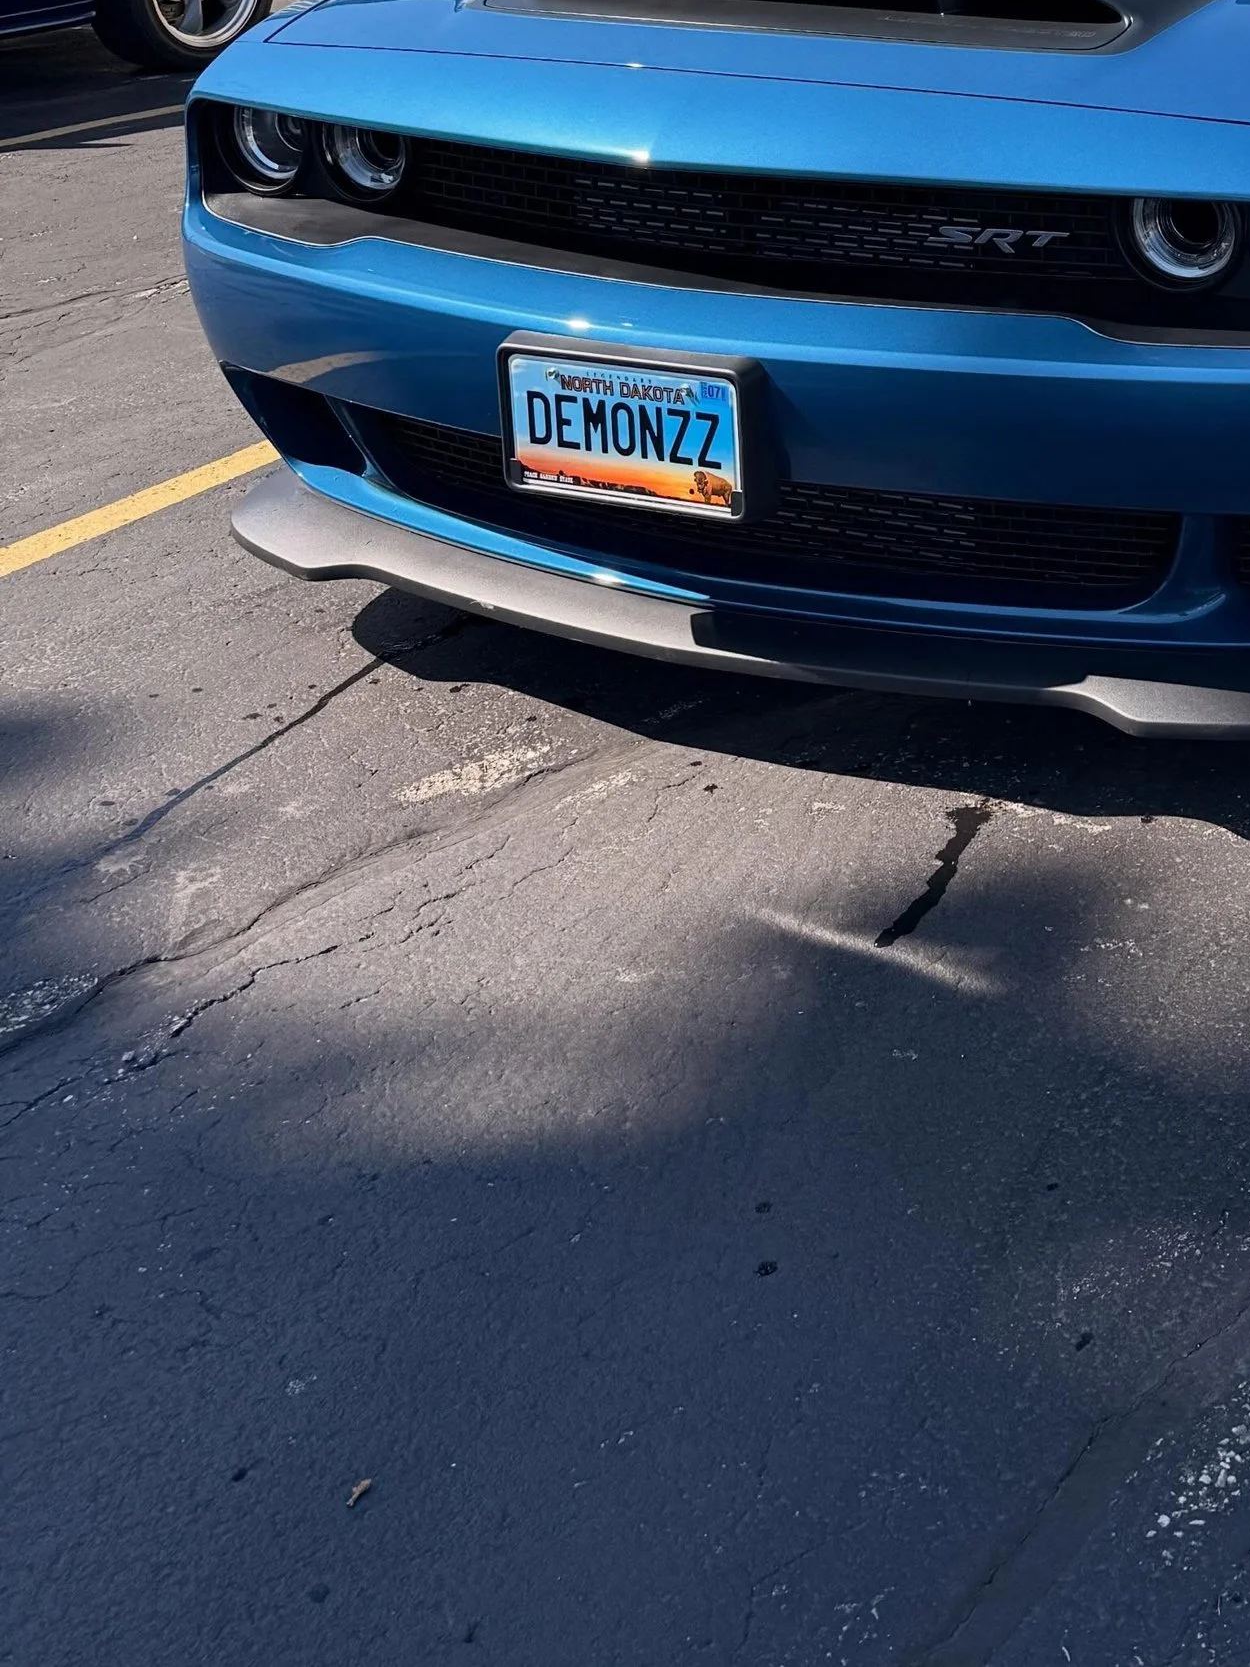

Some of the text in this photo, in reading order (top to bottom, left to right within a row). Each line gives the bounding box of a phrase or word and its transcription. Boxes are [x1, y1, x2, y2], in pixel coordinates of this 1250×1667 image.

[927, 225, 1071, 253] SRT
[560, 374, 615, 397] NORTH
[619, 381, 685, 405] DAKOTA
[708, 385, 720, 399] 07
[526, 390, 722, 470] DEMONZZ
